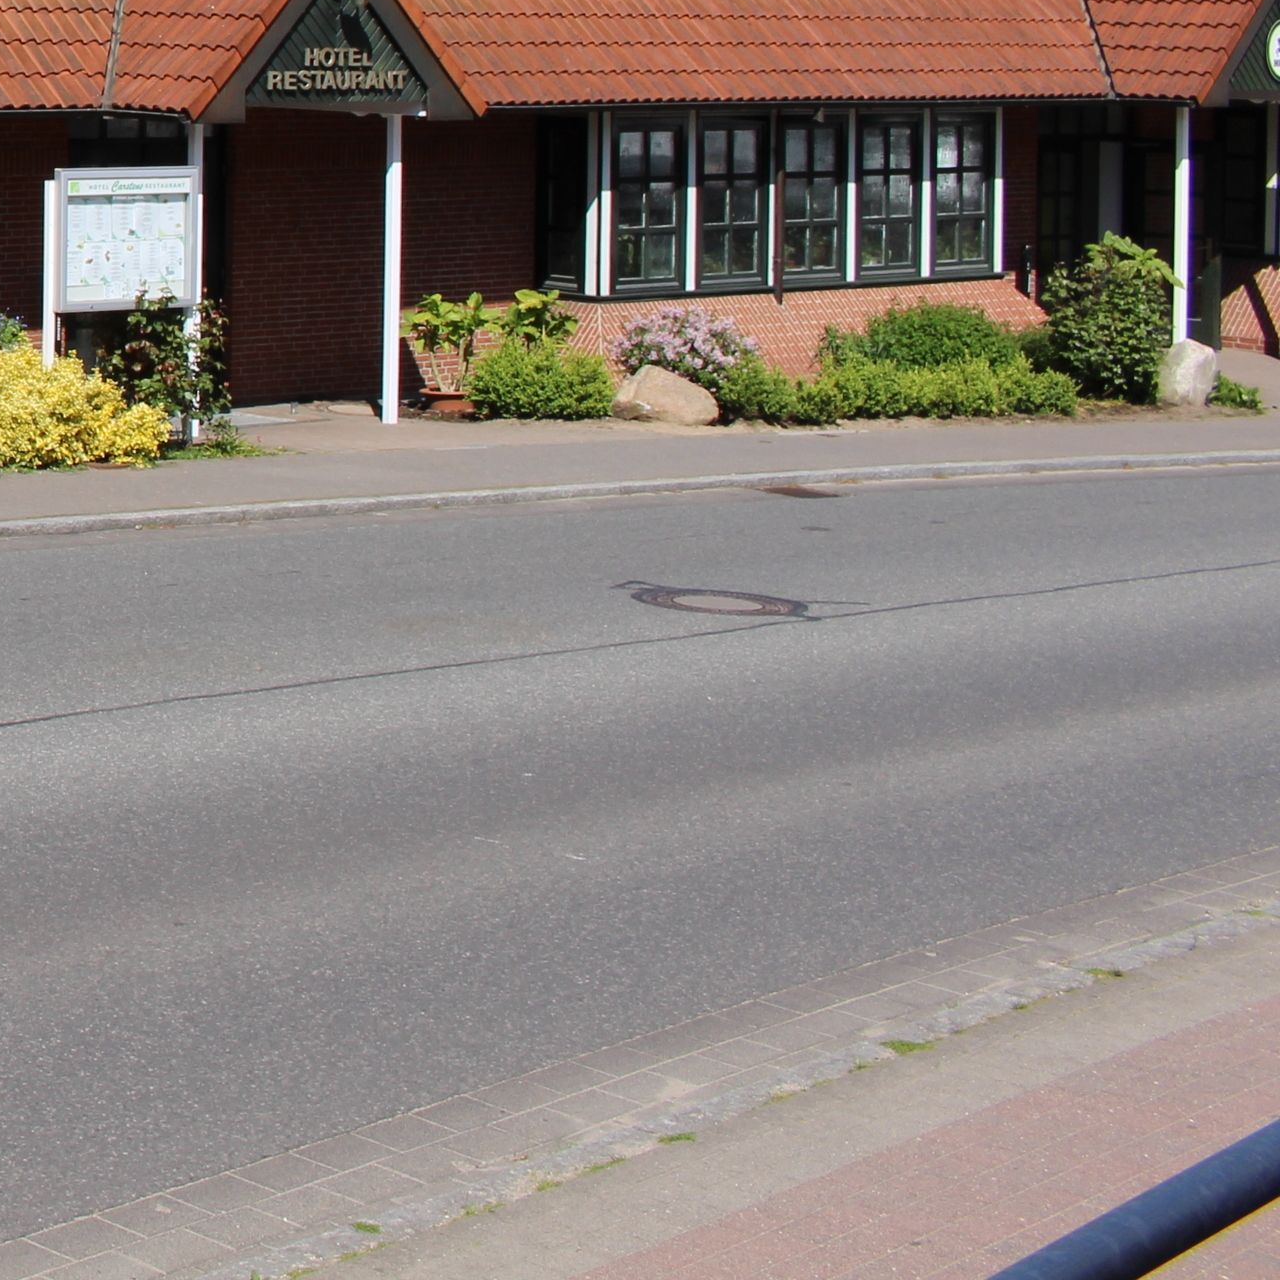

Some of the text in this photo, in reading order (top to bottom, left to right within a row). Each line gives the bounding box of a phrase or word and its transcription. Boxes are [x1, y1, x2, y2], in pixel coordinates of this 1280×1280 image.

[304, 47, 373, 67] HOTEL
[267, 68, 409, 90] RESTAURANT
[111, 180, 144, 192] Carstens
